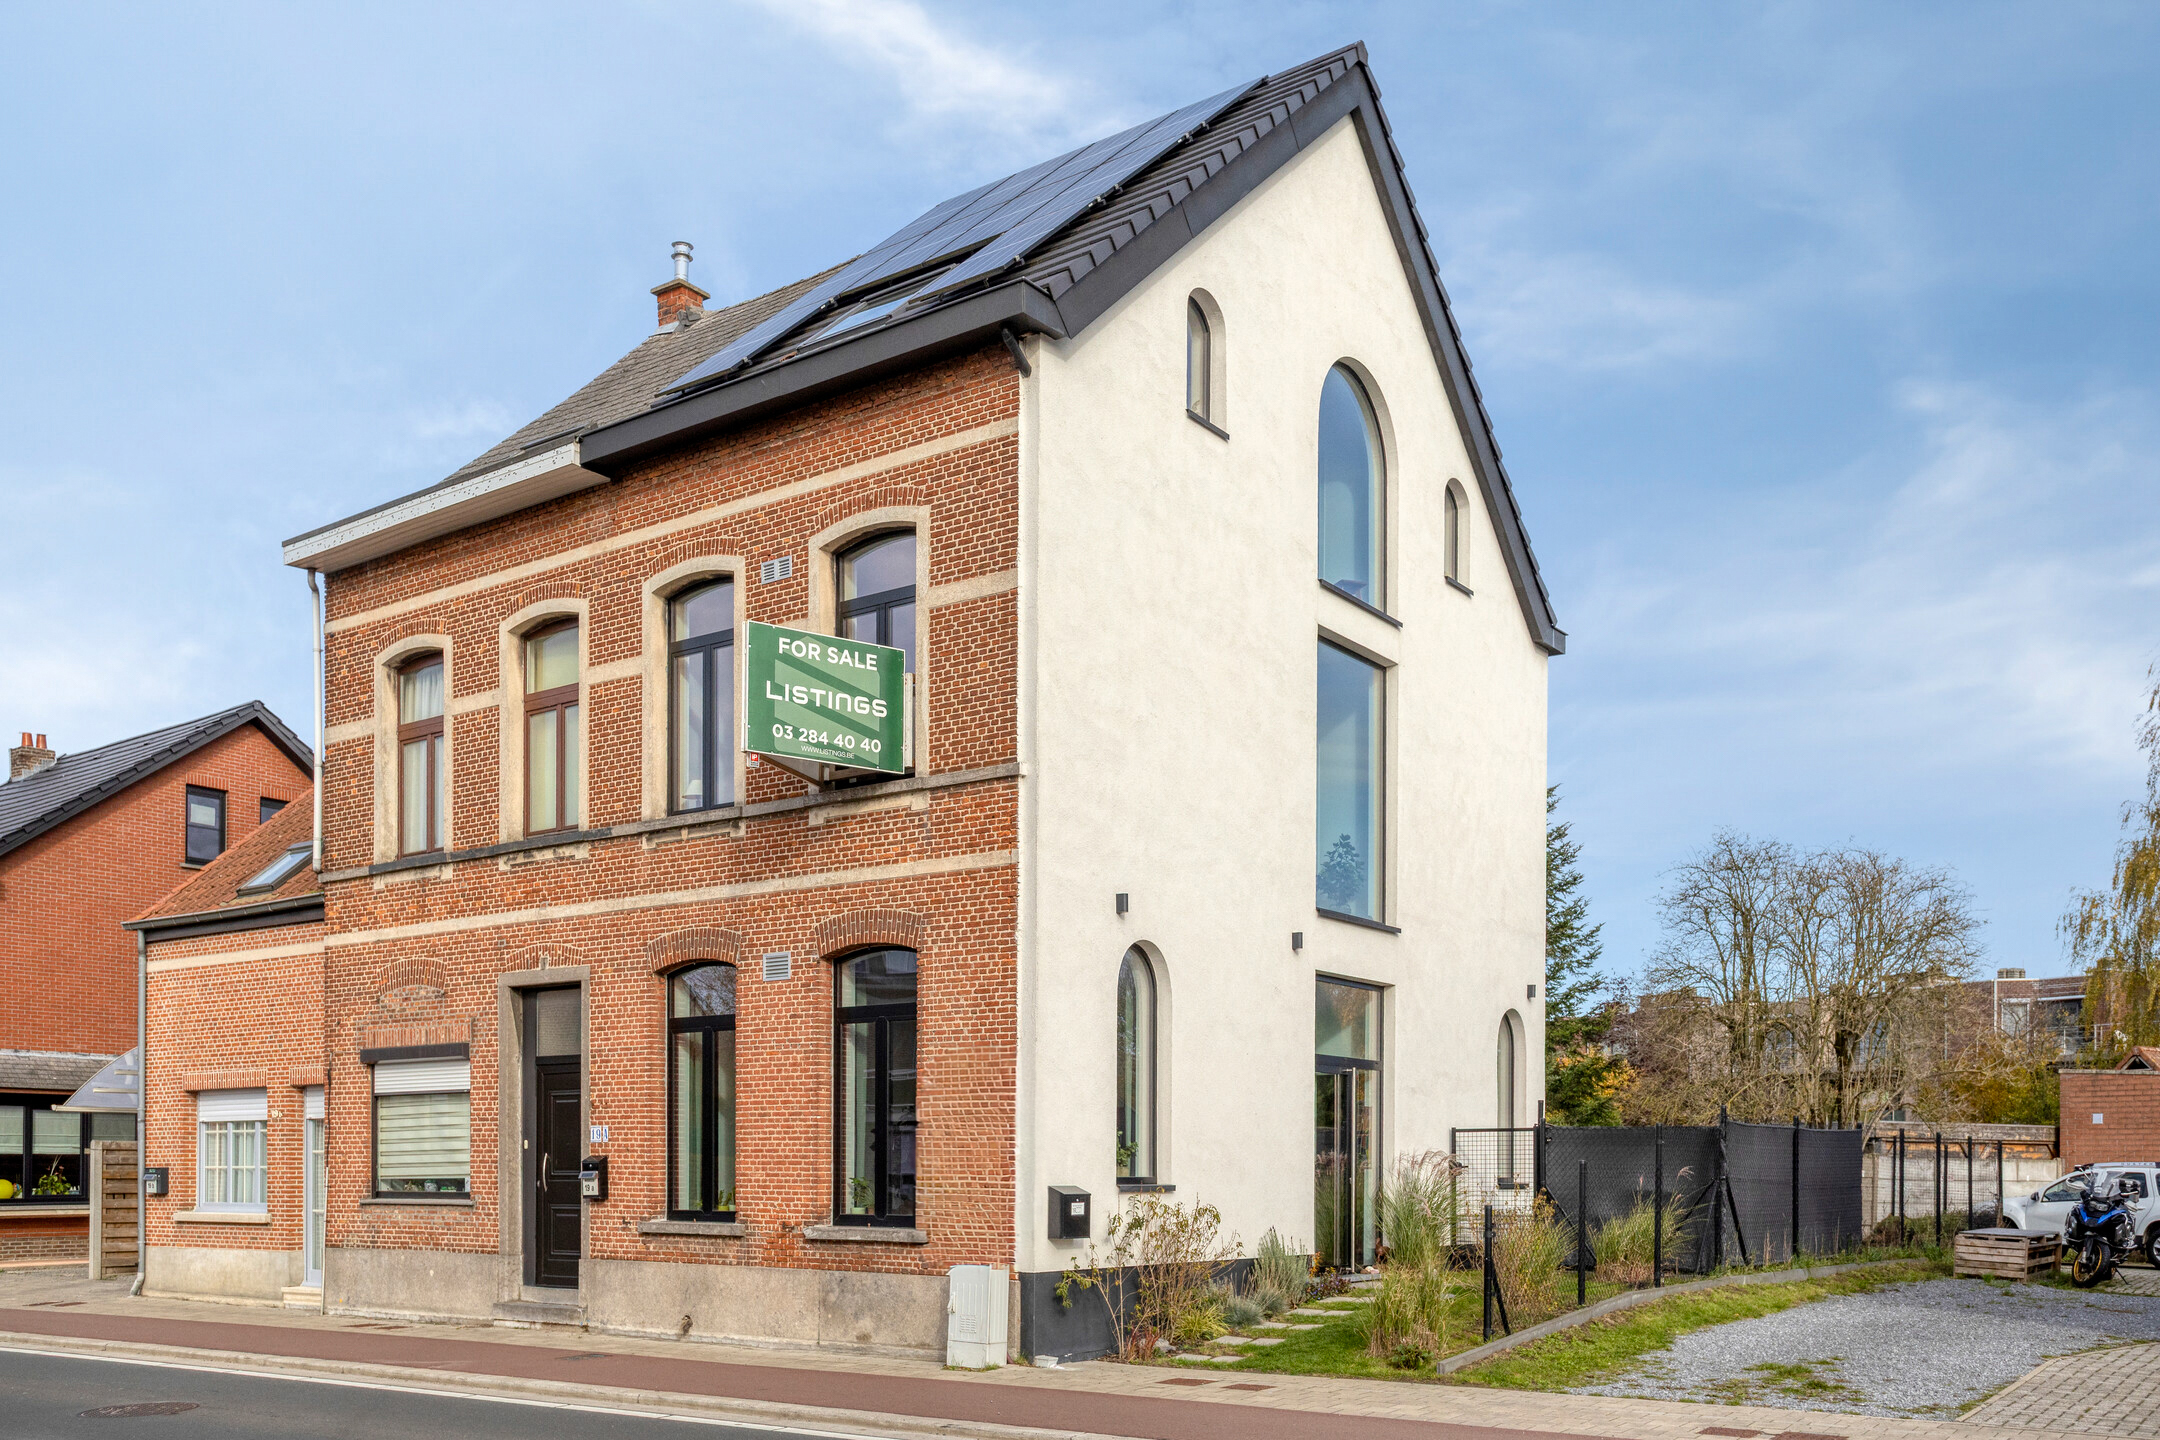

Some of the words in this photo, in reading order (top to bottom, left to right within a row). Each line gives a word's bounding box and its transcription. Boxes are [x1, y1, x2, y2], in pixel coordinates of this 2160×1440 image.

[778, 637, 820, 661] FOR
[827, 646, 878, 671] SALE
[766, 680, 888, 718] LISTINGS
[772, 723, 794, 740] 03
[798, 728, 829, 745] 284
[833, 734, 855, 750] 40
[860, 738, 882, 753] 40
[800, 745, 855, 759] WWW.LISTINGS.BE
[591, 1128, 601, 1140] 19
[603, 1128, 608, 1140] A
